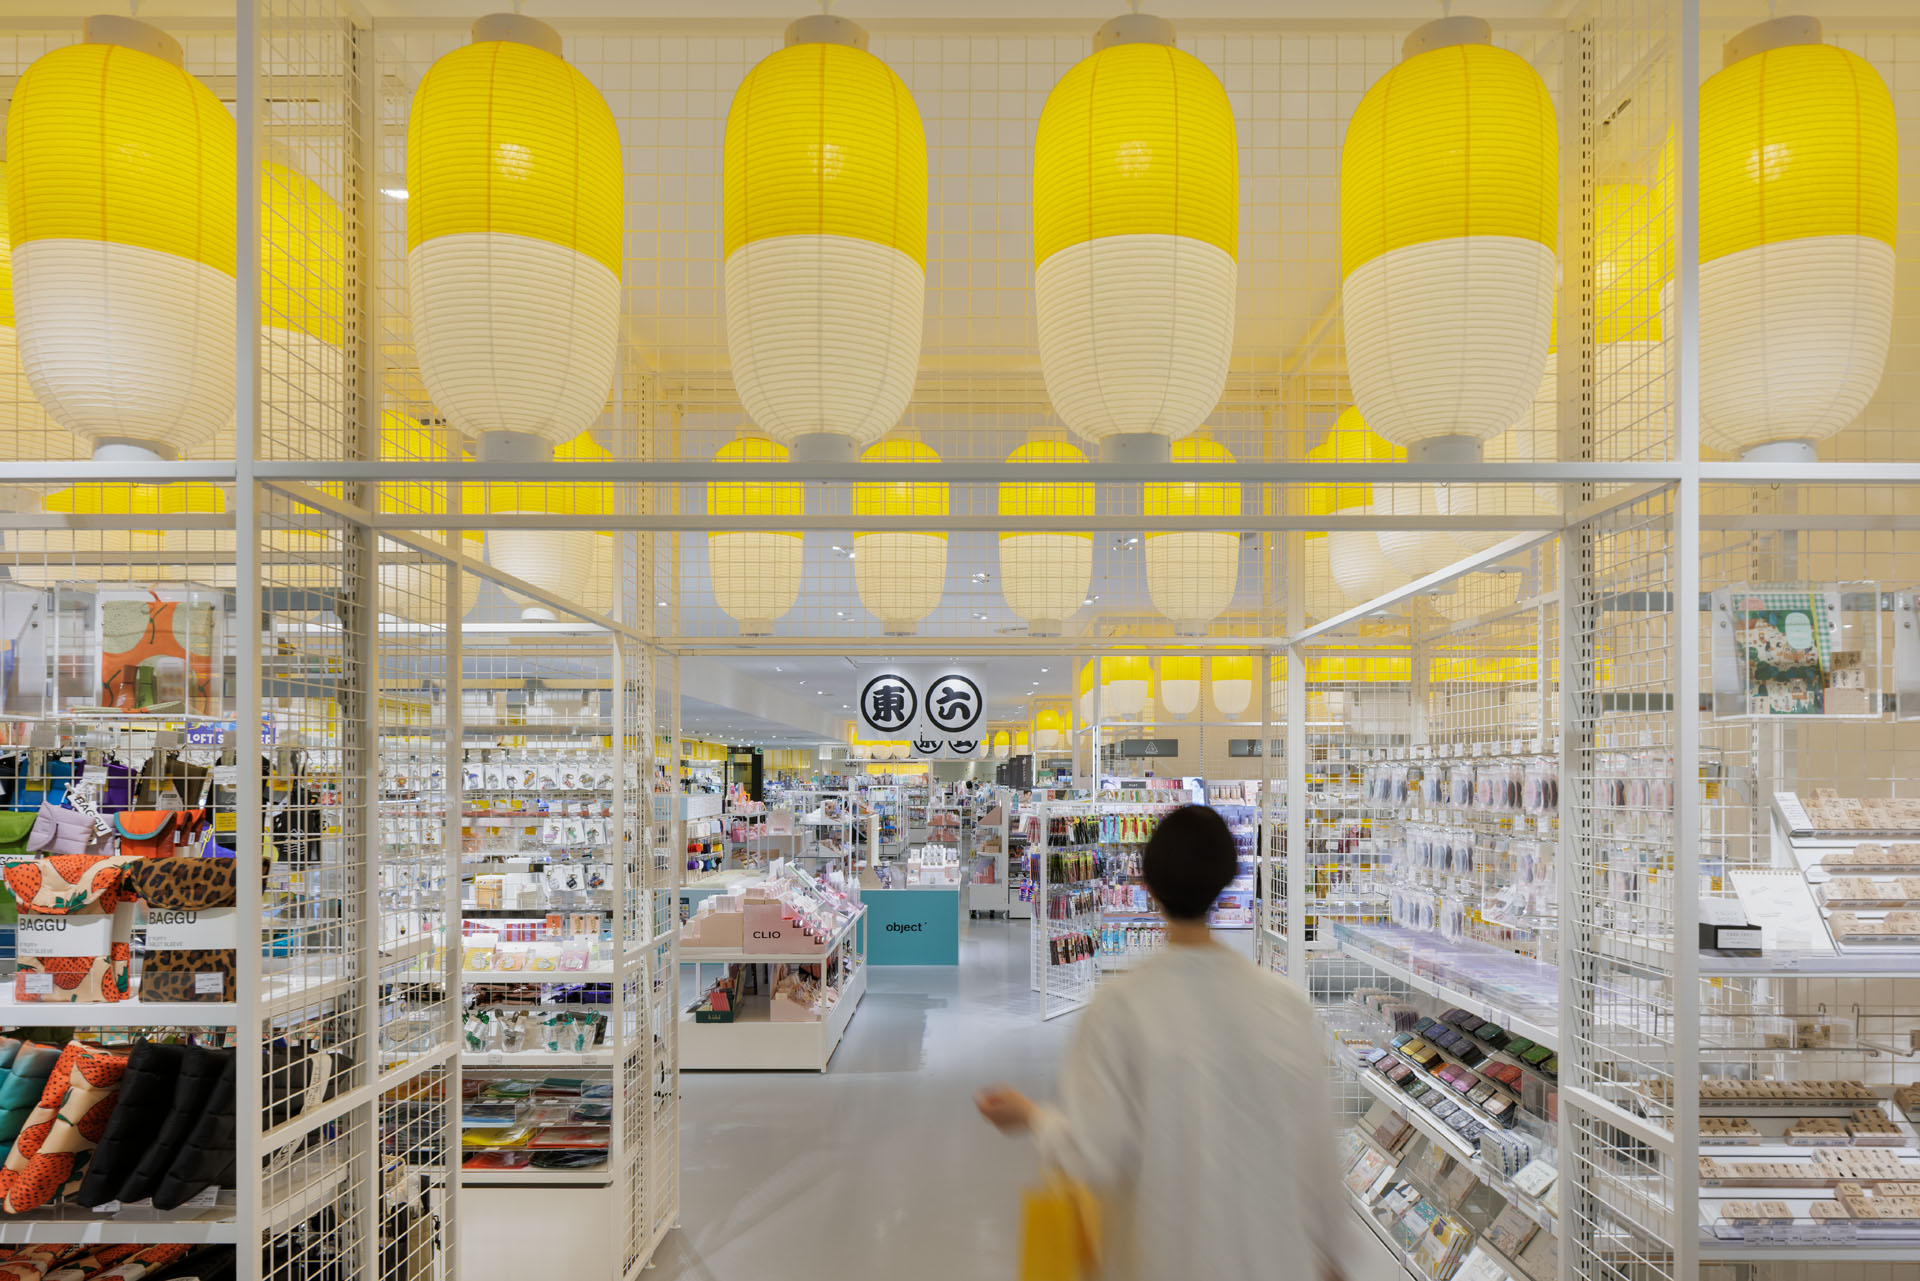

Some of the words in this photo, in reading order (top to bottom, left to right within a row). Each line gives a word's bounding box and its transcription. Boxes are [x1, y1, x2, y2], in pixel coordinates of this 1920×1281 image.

[872, 685, 905, 722] 東
[187, 733, 214, 744] LOFT
[73, 796, 108, 833] BAGGU
[20, 918, 67, 932] BAGGU
[149, 911, 197, 925] BAGGU
[752, 930, 781, 939] CLIO
[886, 922, 922, 934] object
